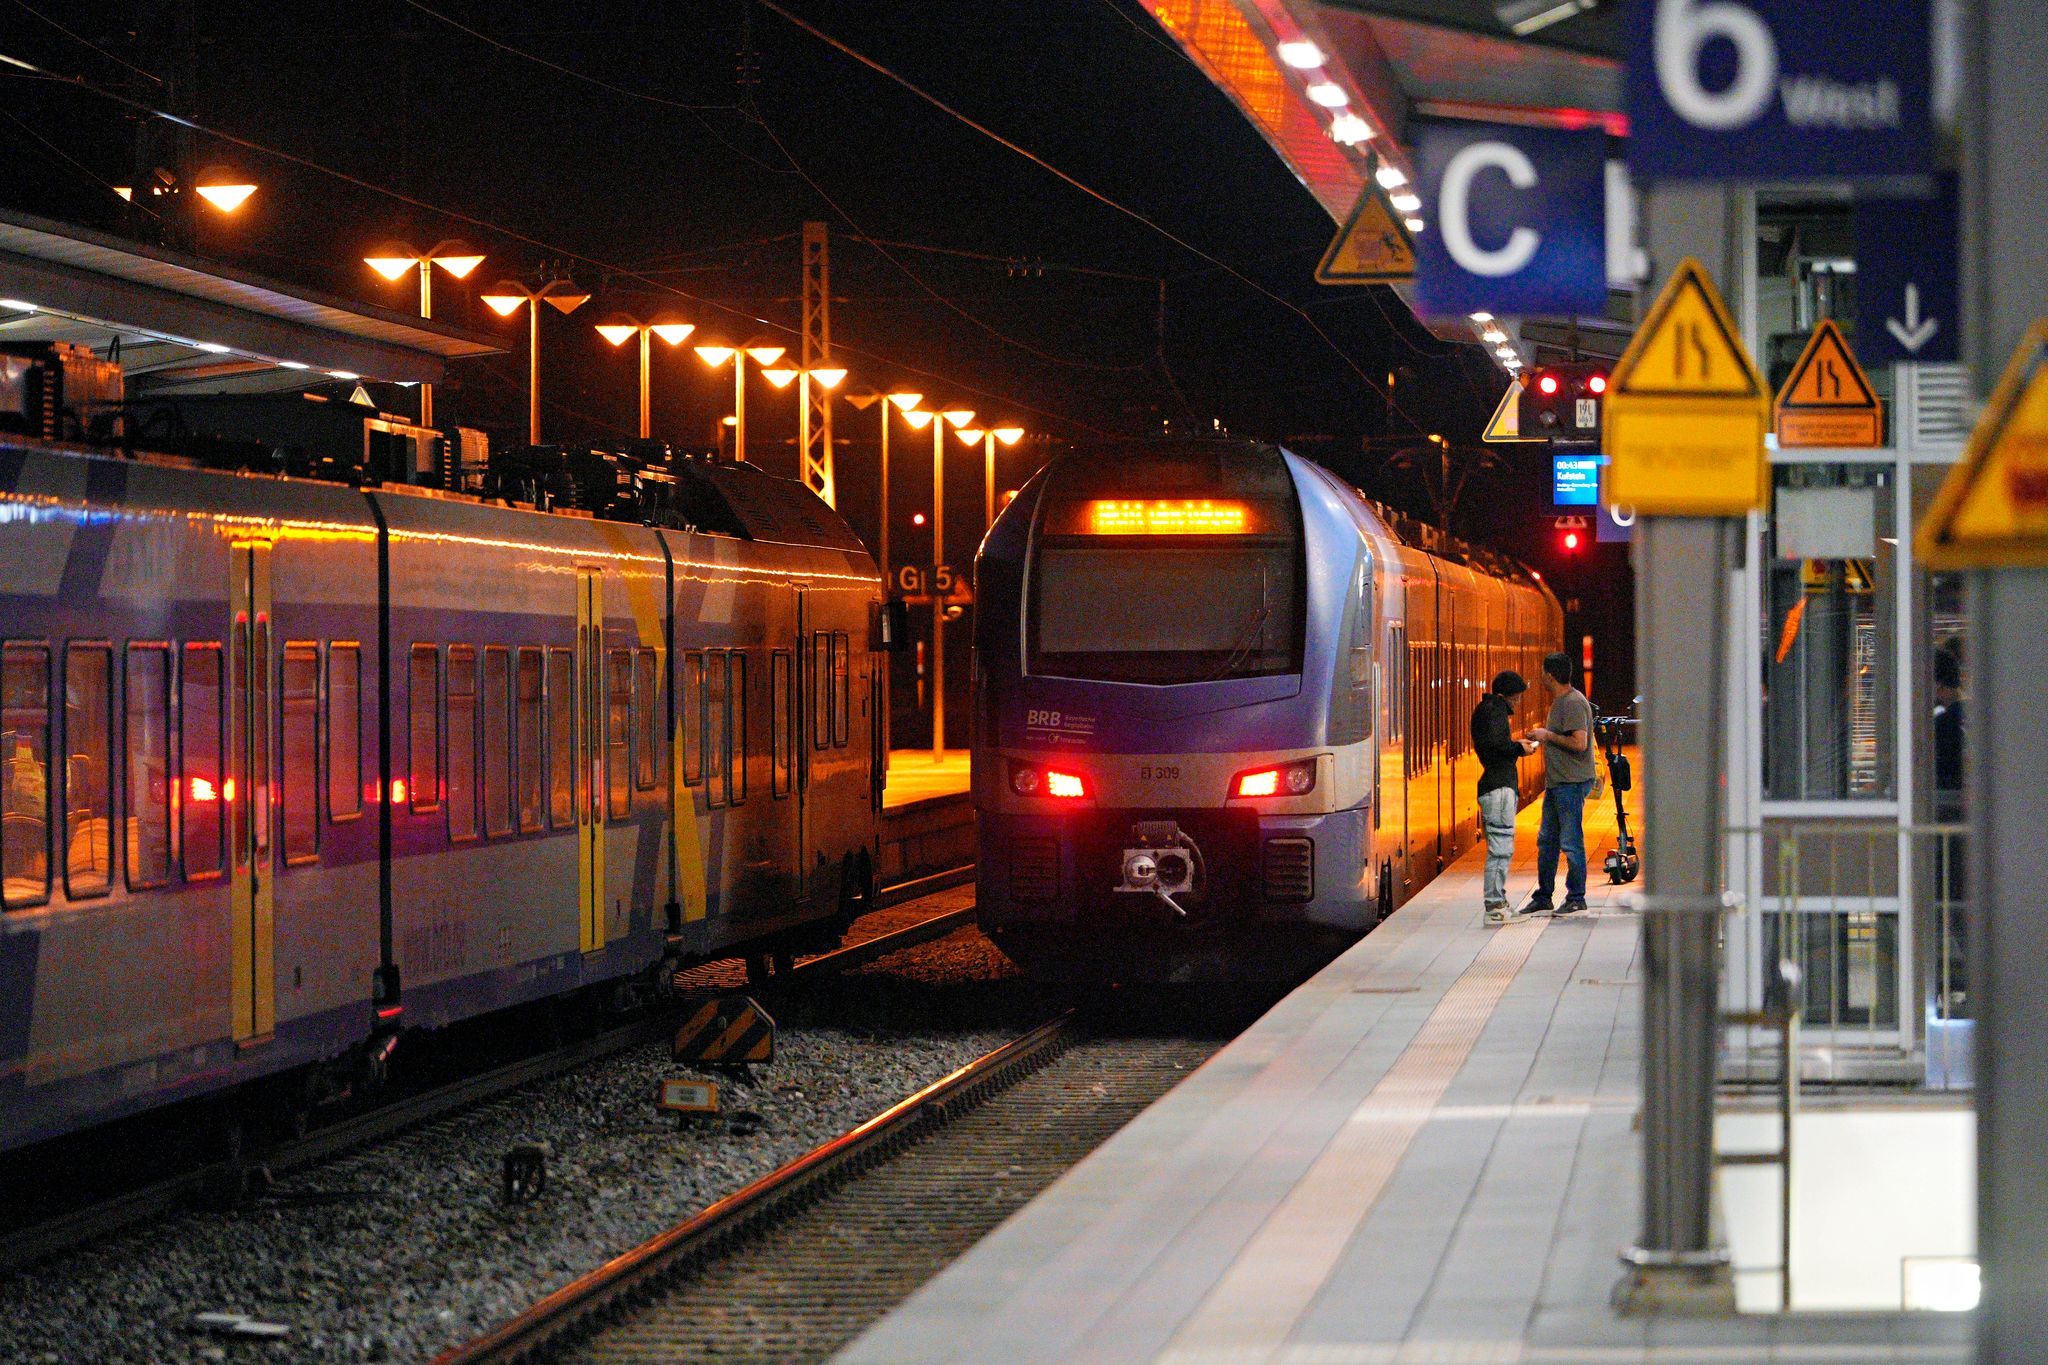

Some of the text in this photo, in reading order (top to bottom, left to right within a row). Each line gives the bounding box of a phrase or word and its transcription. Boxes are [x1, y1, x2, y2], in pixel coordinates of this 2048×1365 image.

[1653, 0, 1778, 129] 6
[1439, 142, 1541, 277] C
[935, 566, 952, 590] 5
[1027, 709, 1061, 726] BRB
[1155, 766, 1180, 779] 309
